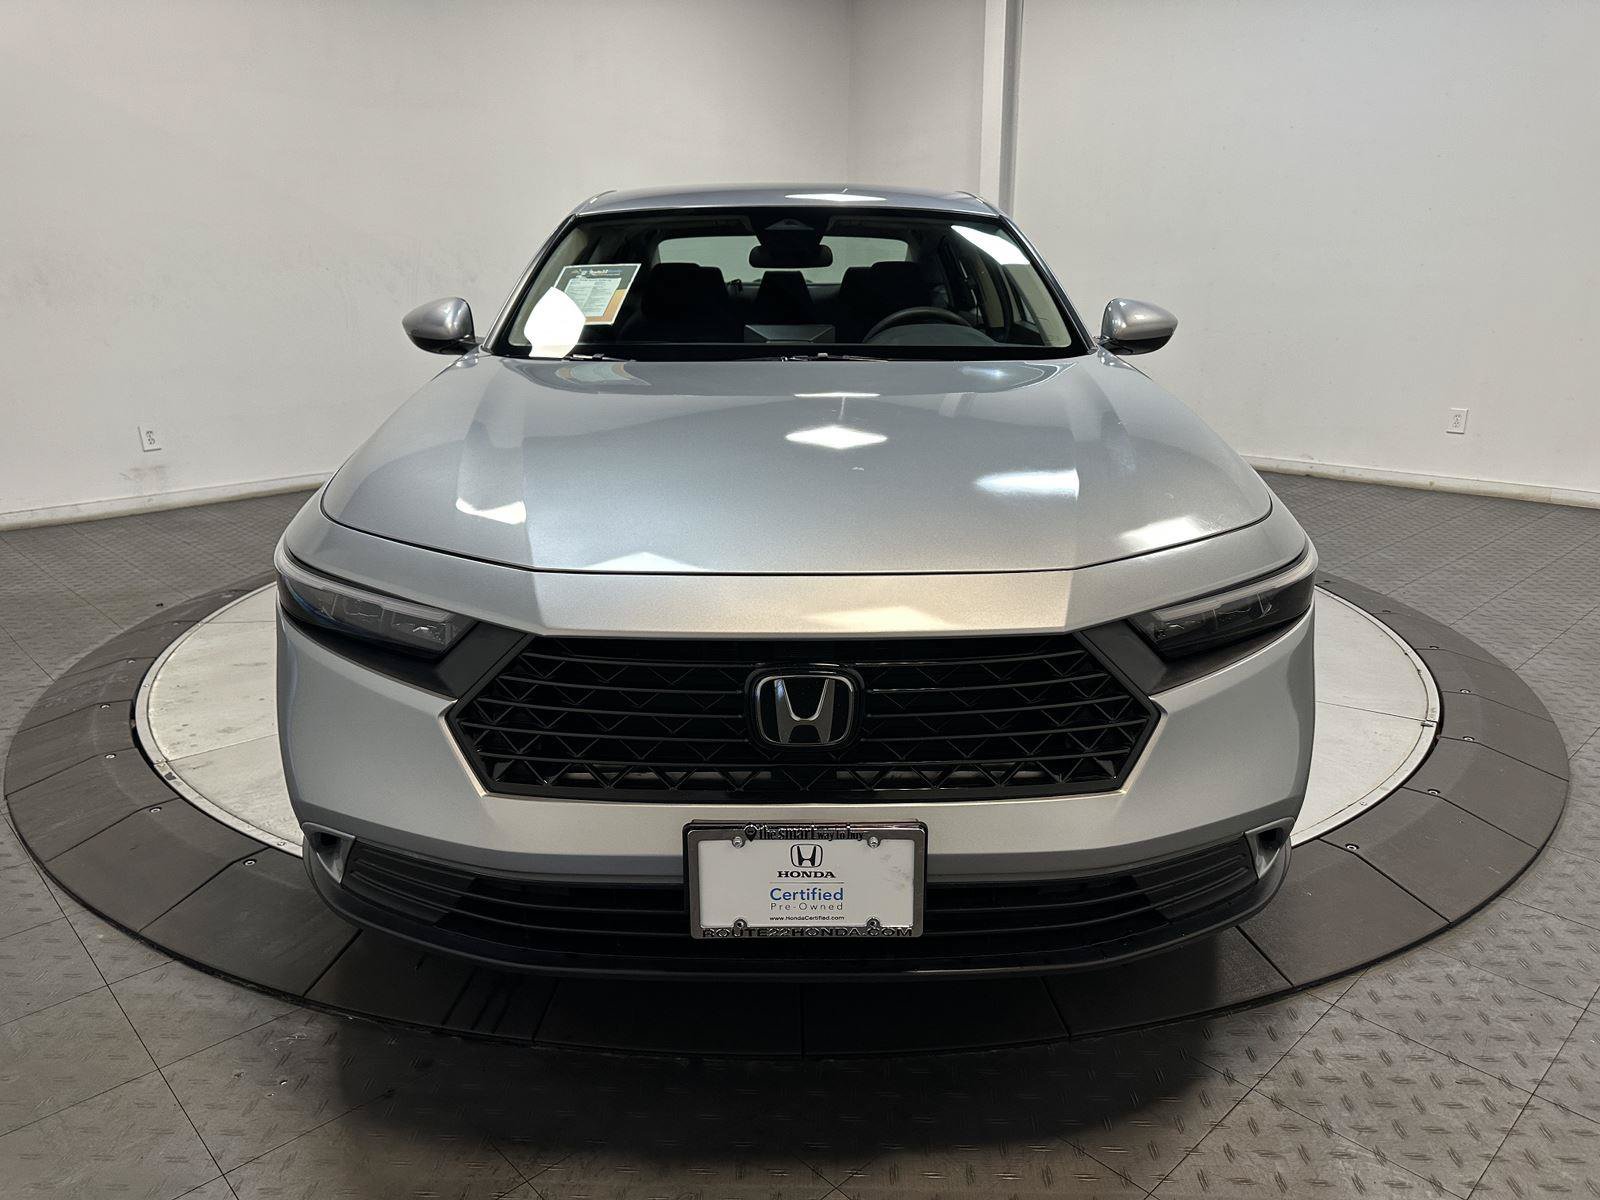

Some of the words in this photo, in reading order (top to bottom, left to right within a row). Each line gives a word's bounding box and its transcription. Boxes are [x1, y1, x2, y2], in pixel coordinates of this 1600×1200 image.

[817, 829, 835, 841] way
[836, 826, 846, 840] to
[777, 870, 836, 879] HONDA
[769, 887, 844, 901] Certified
[770, 902, 843, 911] Pre-Owned
[702, 926, 912, 938] ROUTE22HONDA.COM
